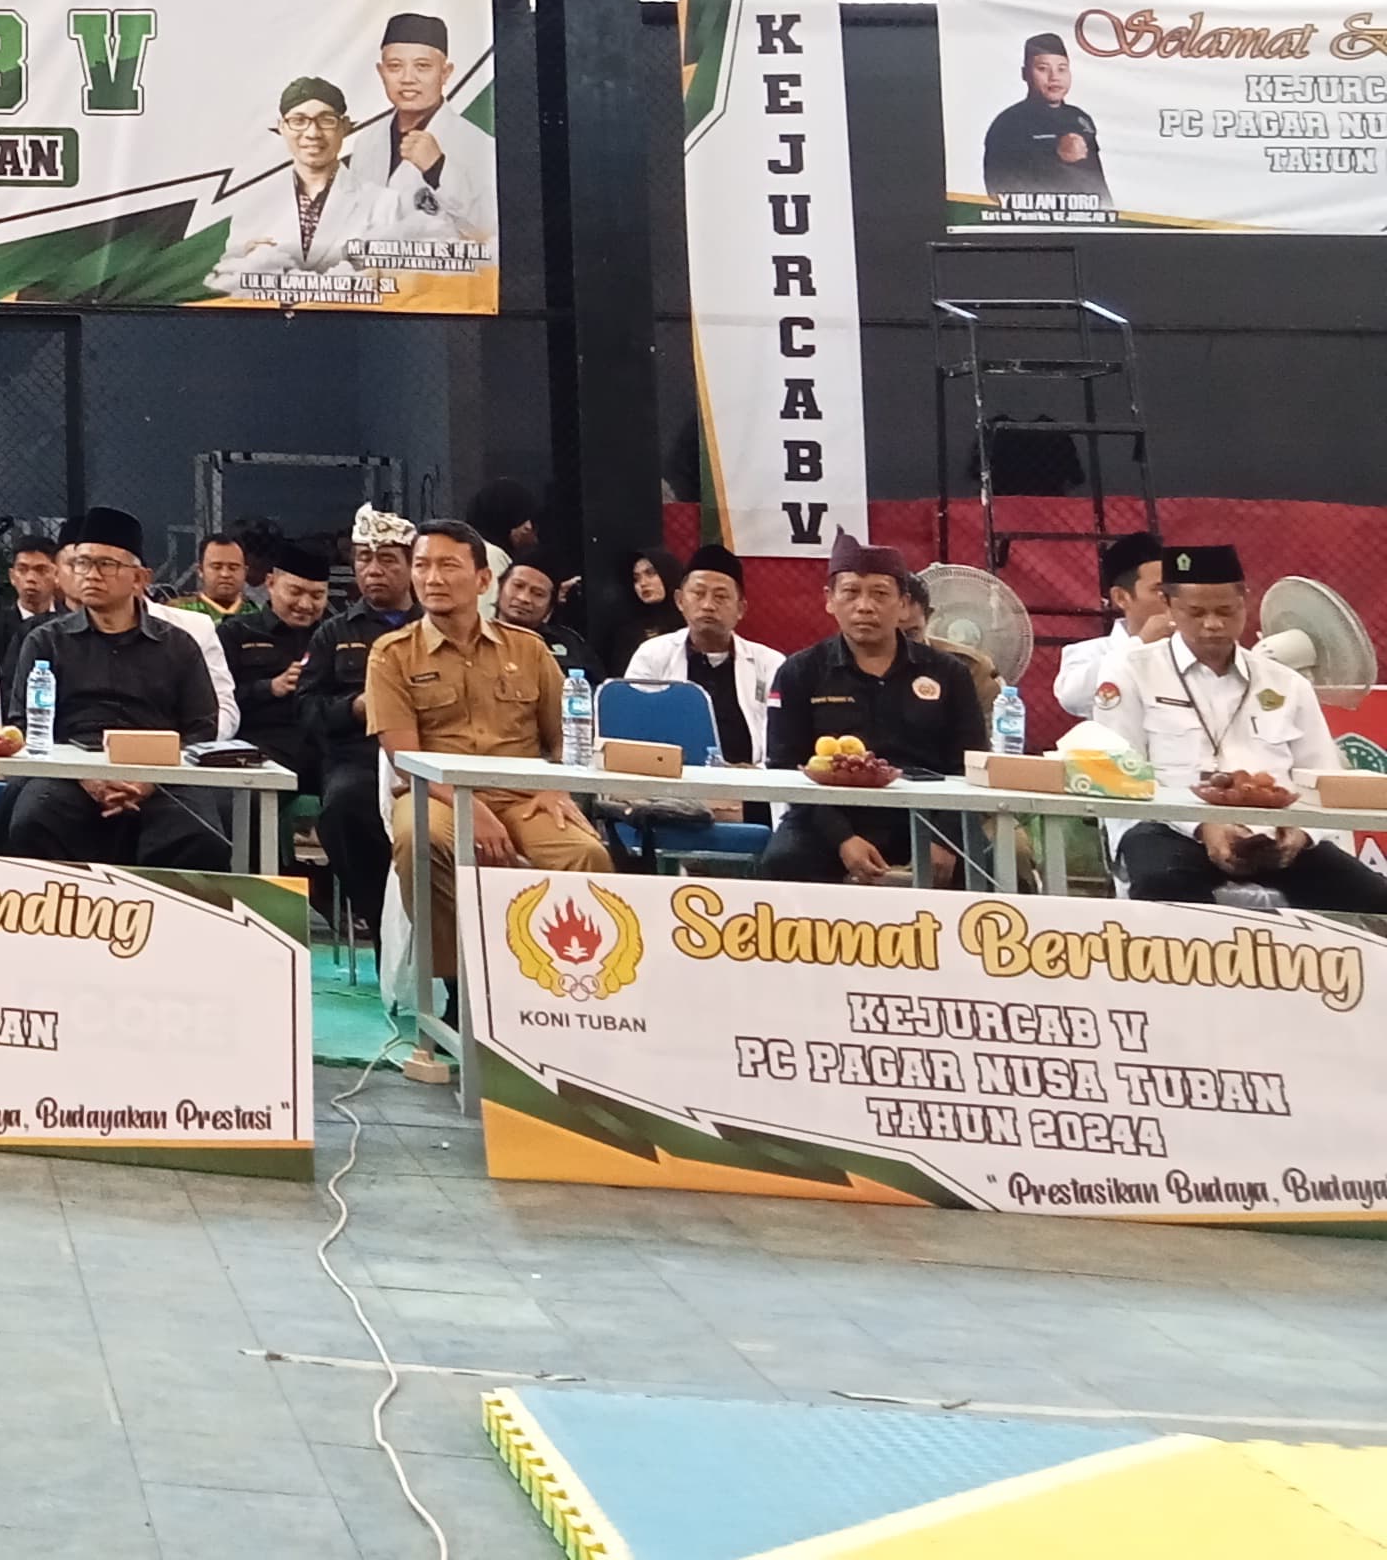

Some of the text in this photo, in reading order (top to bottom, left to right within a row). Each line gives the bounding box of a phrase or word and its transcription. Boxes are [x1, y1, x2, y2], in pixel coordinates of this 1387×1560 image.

[1074, 8, 1319, 59] Selamat
[67, 9, 156, 116] V
[1159, 109, 1204, 138] PC
[1213, 109, 1329, 138] PAGAR
[1264, 146, 1377, 174] TAHUN
[670, 883, 1364, 1012] Selamat Bertanding
[519, 1010, 647, 1033] KONI TUBAN
[847, 992, 1148, 1053] KEJURCAB V
[735, 1036, 1291, 1116] PC PAGAR NUSA TUBAN
[35, 1096, 167, 1136] Budayakan
[175, 1099, 272, 1132] Prestasi
[867, 1096, 1167, 1158] TAHUN 20244
[1008, 1171, 1160, 1205] Prestasikan
[1165, 1168, 1279, 1210] Budaya,
